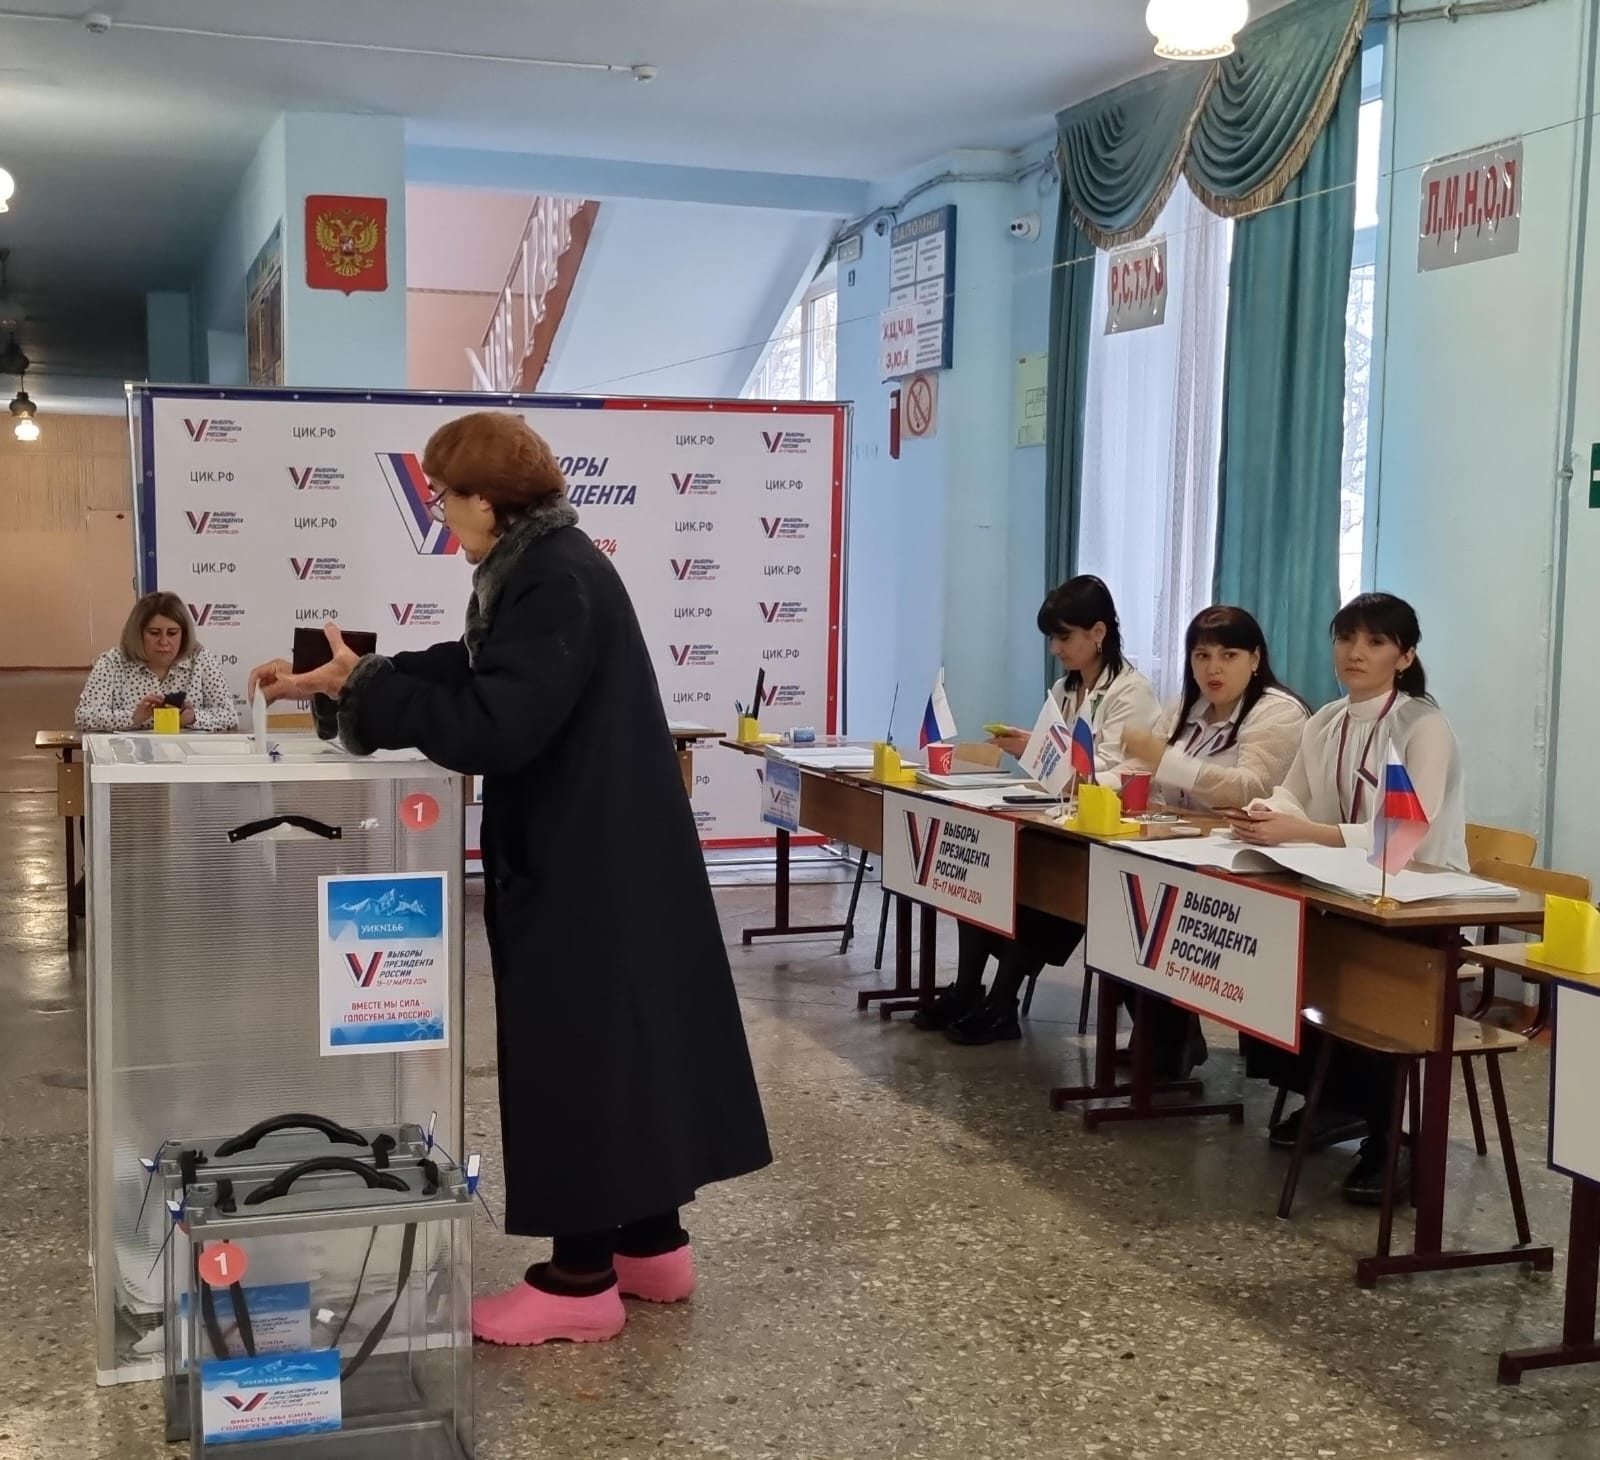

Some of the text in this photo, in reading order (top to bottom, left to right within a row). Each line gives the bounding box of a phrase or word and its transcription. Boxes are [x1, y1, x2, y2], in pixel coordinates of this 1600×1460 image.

[293, 427, 336, 440] ЦИК.РФ
[676, 436, 714, 446] ЦИК.РФ
[190, 472, 234, 484] ЦИК.РФ
[765, 481, 803, 491] ЦИК.РФ
[294, 518, 337, 530] ЦИК.РФ
[675, 522, 713, 533] ЦИК.РФ
[192, 563, 236, 575] ЦИК.РФ
[764, 566, 801, 576] ЦИК.РФ
[296, 609, 338, 620] ЦИК.РФ
[674, 608, 712, 618] ЦИК.РФ
[762, 649, 800, 660] ЦИК.РФ
[673, 692, 711, 703] ЦИК.РФ
[413, 801, 424, 823] 1
[943, 821, 980, 844] ВЫБОРЫ
[939, 841, 991, 868] ПРЕЗИДЕНТА
[935, 859, 968, 882] РОССИИ
[948, 883, 967, 901] МАРТА
[966, 890, 982, 905] 2024
[1184, 891, 1241, 924] ВЫБОРЫ
[1176, 915, 1258, 957] ПРЕЗИДЕНТА
[387, 950, 423, 959] ВЫБОРЫ
[1170, 938, 1222, 971] РОССИИ
[384, 958, 434, 968] ПРЕЗИДЕНТА
[380, 970, 412, 978] РОССИИ
[1189, 970, 1220, 994] МАРТА
[1220, 981, 1244, 1004] 2024
[352, 1001, 382, 1010] ВМЕСТЕ
[400, 1000, 420, 1008] СИЛА
[344, 1010, 433, 1022] ГОЛОСУЕМ ЗА РОССИЮ!
[214, 1252, 228, 1276] 1
[230, 1416, 266, 1424] ВМЕСТЕ
